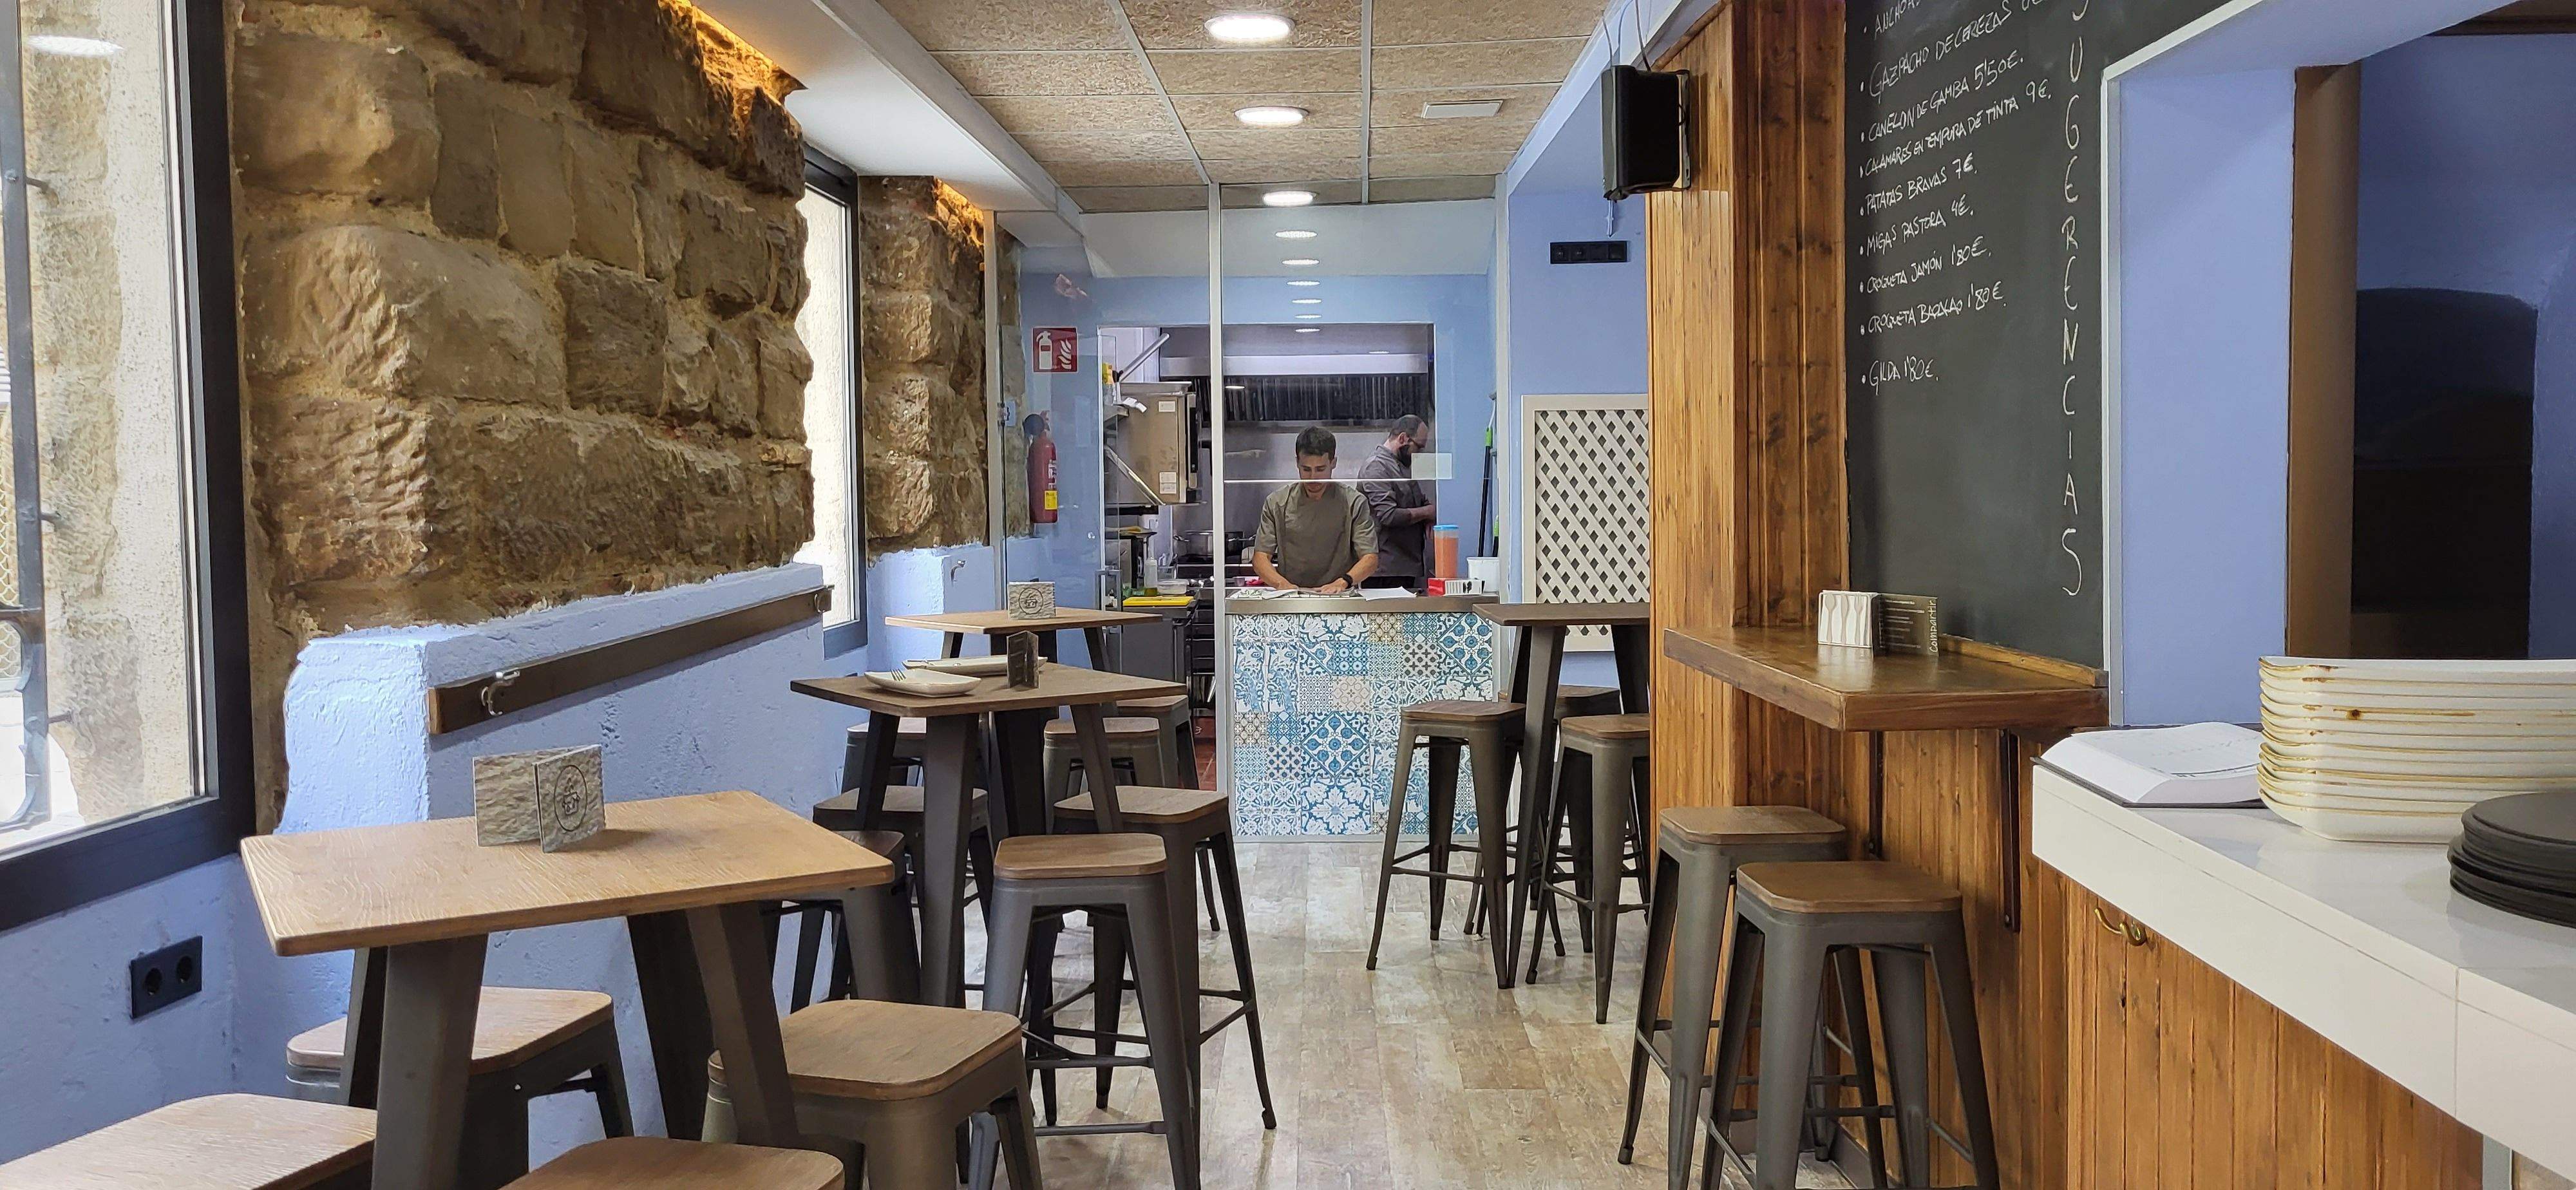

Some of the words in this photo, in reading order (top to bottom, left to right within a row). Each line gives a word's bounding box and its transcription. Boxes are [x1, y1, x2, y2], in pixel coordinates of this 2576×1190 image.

[1875, 0, 1920, 40] ANCHOA
[1870, 46, 1929, 104] GAZPACHO
[1929, 76, 1970, 114] GAMBA
[1865, 140, 1913, 176] CALAMARES
[1866, 184, 1903, 215] PATATAS
[1908, 166, 1947, 200] BRAVAS
[1867, 225, 1897, 257] MIGAS
[1901, 209, 1947, 243] PASTORA
[1867, 270, 1908, 294] CROQUETA
[1868, 307, 1917, 334] CROQUETA
[1869, 360, 1901, 396] GILDA
